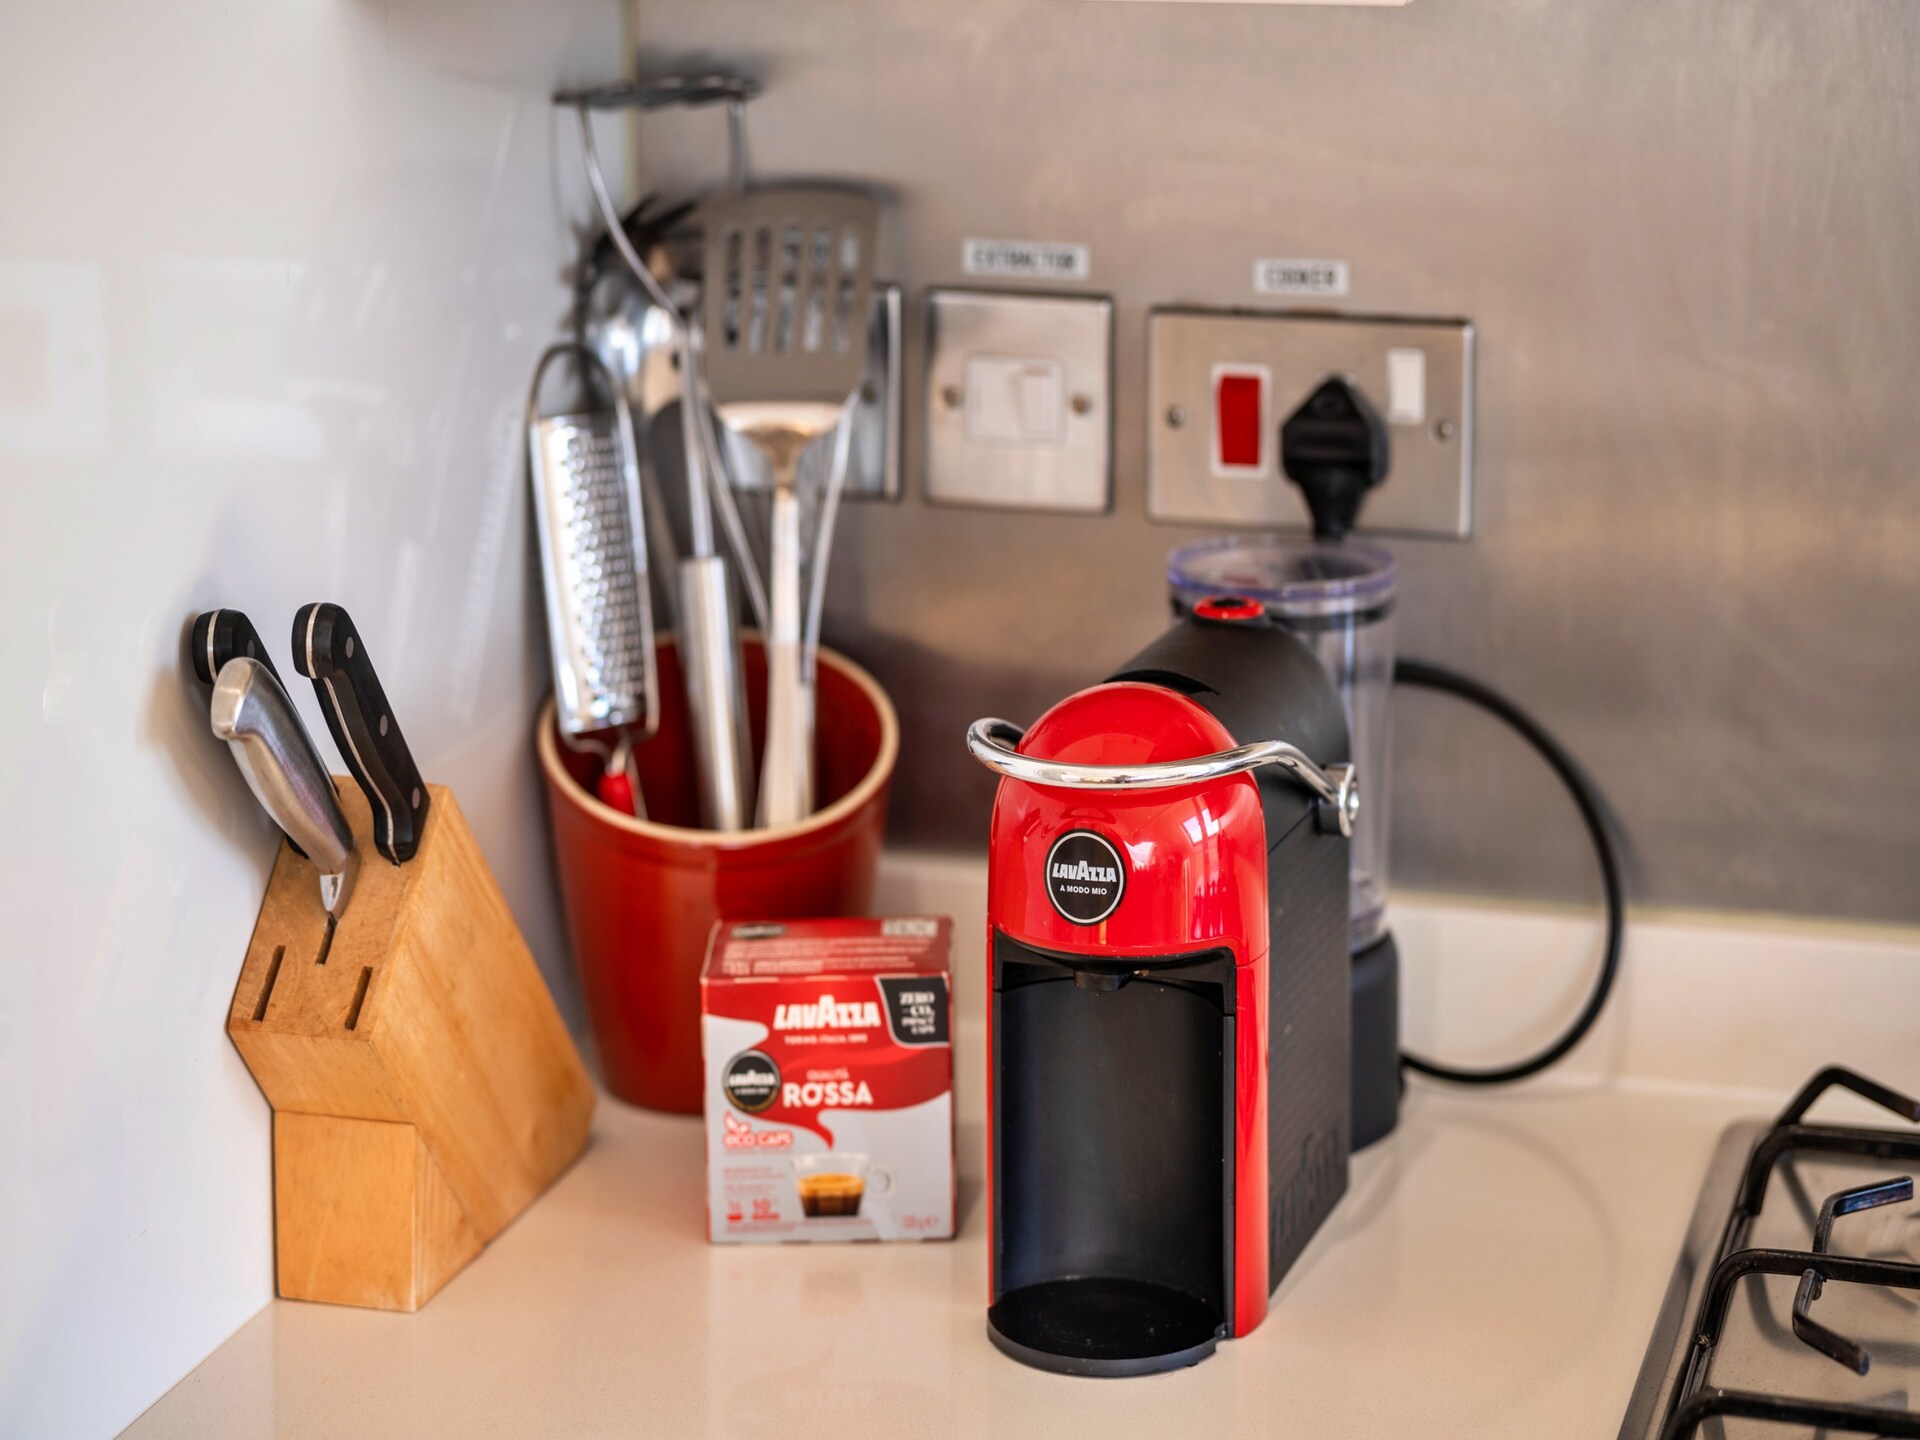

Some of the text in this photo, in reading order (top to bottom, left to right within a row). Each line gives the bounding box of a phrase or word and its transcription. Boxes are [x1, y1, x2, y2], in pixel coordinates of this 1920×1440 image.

[1052, 860, 1117, 882] LAVAZZA
[1067, 885, 1090, 894] MODO
[1092, 887, 1107, 896] MIO
[773, 994, 882, 1030] LAVAZZA
